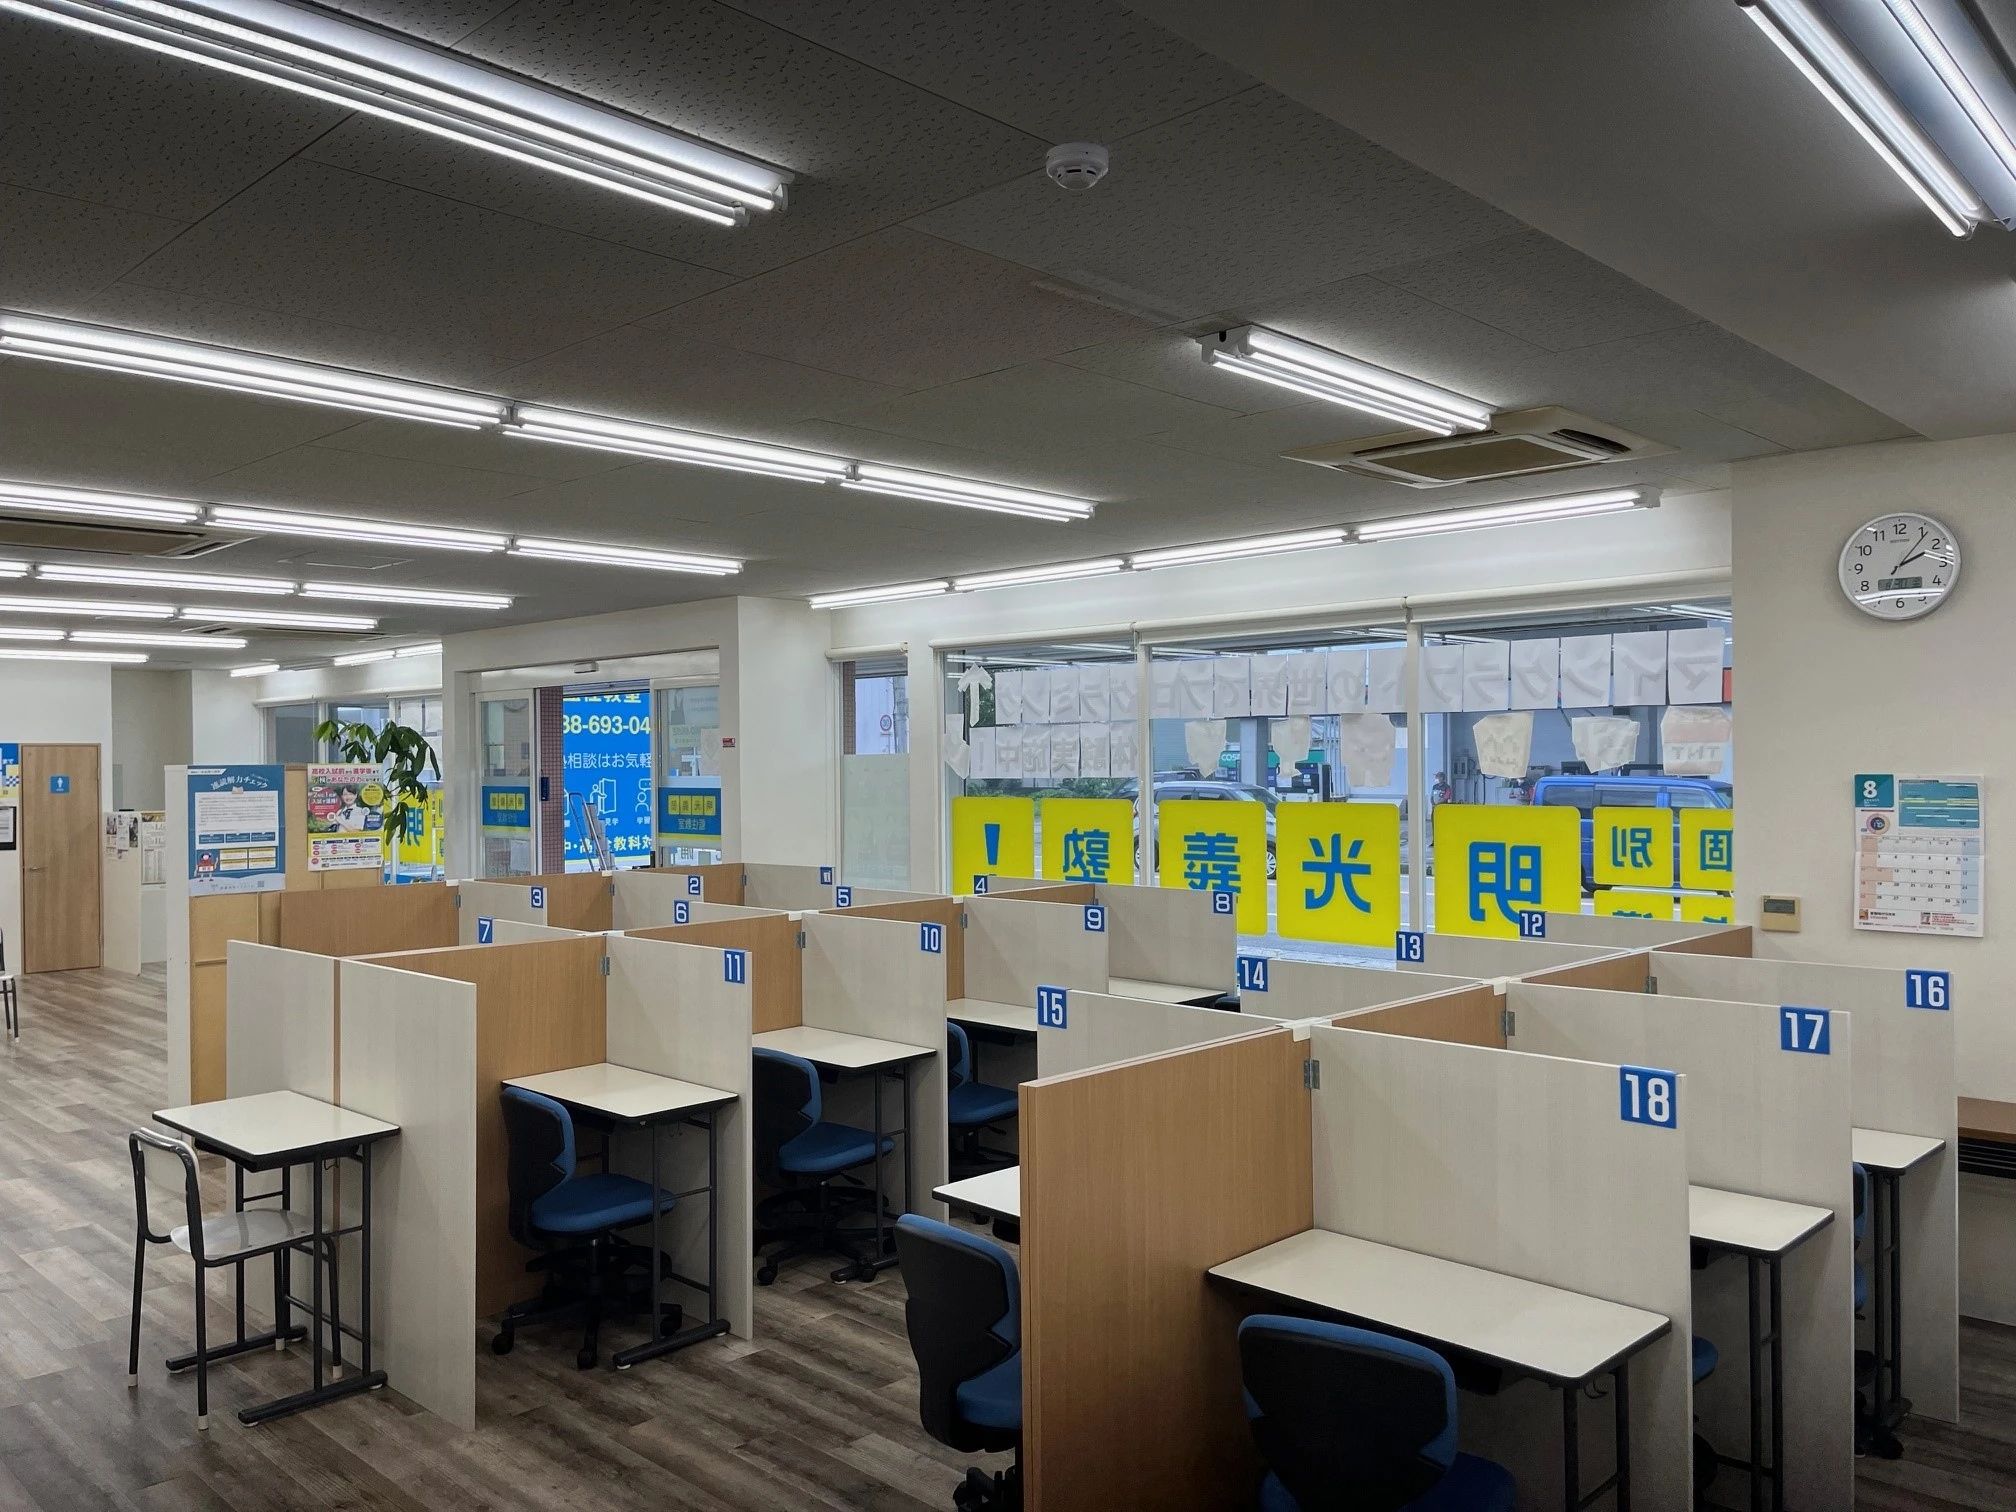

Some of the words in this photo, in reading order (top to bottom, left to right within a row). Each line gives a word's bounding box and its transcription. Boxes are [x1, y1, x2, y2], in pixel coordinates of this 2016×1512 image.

[1873, 530, 1885, 541] 11
[1893, 523, 1907, 535] 12
[1859, 545, 1872, 556] 10
[1931, 538, 1940, 550] 2
[1854, 563, 1863, 575] 9
[1860, 580, 1869, 591] 8
[1932, 575, 1942, 586] 4
[1896, 598, 1905, 608] 6
[1863, 780, 1877, 798] 8
[689, 877, 700, 894] 2
[975, 877, 986, 895] 4
[531, 888, 542, 907] 3
[838, 888, 850, 907] 5
[1215, 893, 1231, 913] 8
[676, 902, 688, 922] 6
[1086, 908, 1103, 930] 9
[480, 919, 491, 943] 7
[1521, 913, 1543, 936] 12
[922, 926, 940, 951] 10
[1398, 934, 1421, 960] 13
[726, 953, 744, 982] 11
[1242, 959, 1265, 989] 14
[1911, 974, 1945, 1007] 16
[1040, 990, 1063, 1025] 15
[1785, 1012, 1825, 1050] 17
[1625, 1074, 1670, 1123] 18
